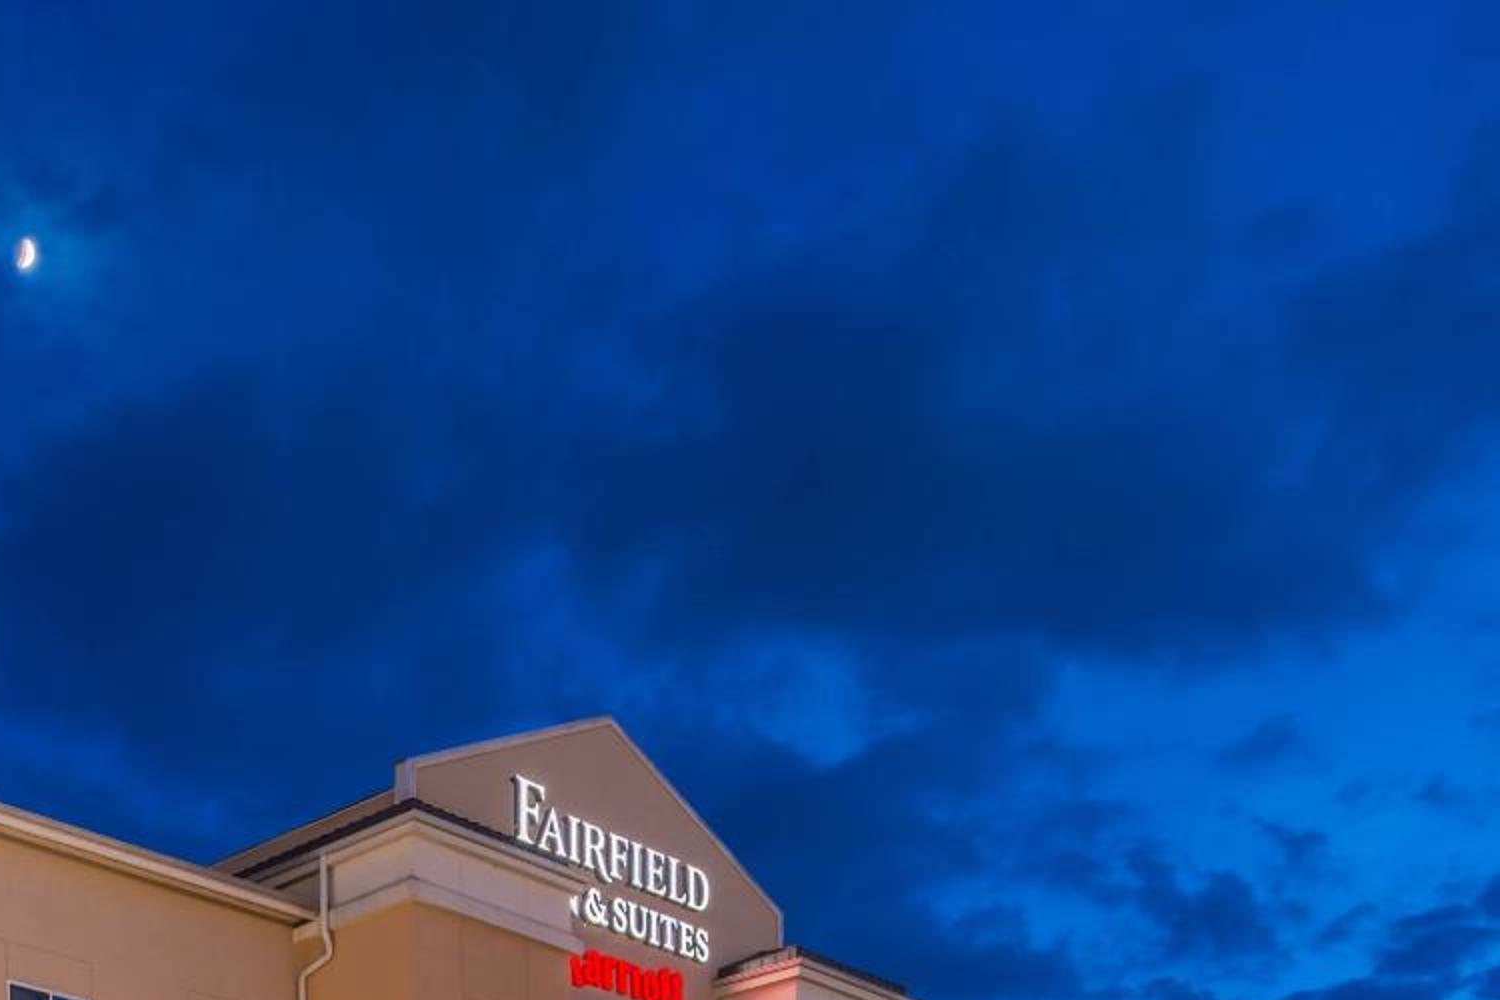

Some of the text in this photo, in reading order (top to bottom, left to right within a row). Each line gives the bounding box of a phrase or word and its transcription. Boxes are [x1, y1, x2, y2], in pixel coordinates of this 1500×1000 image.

[514, 774, 710, 912] FAIRFIELD
[585, 887, 609, 927] &
[612, 897, 710, 963] SUITES
